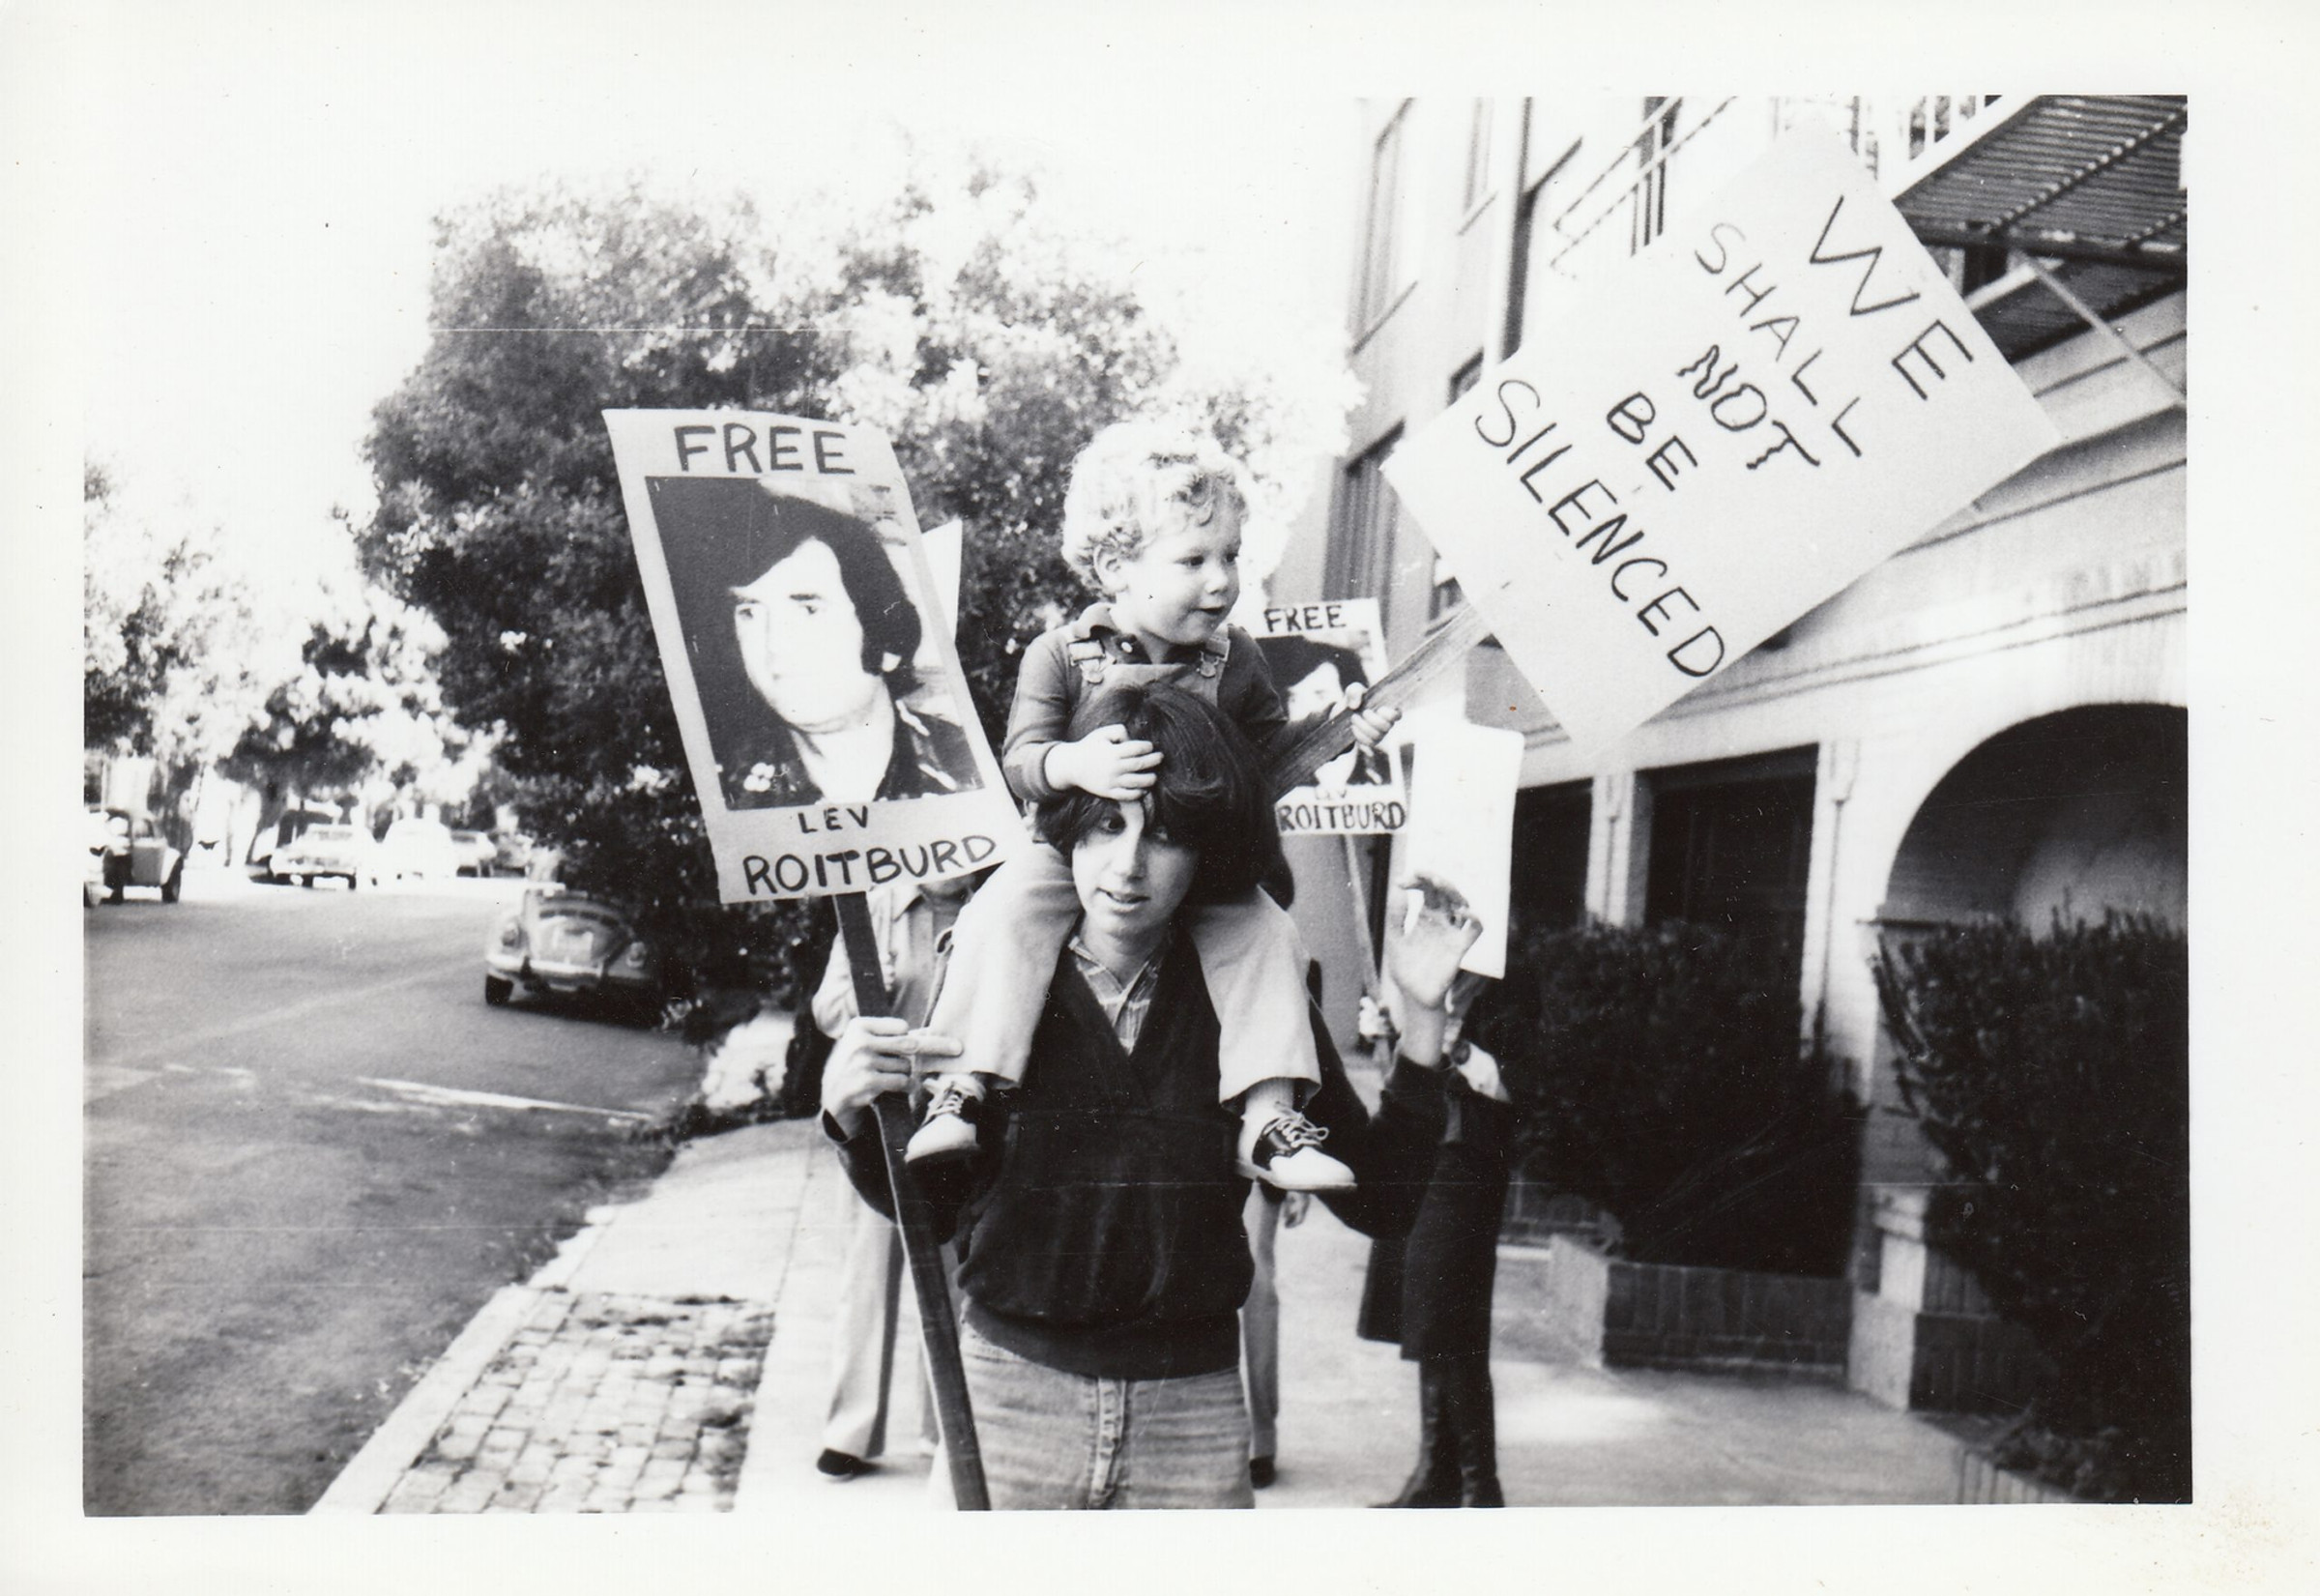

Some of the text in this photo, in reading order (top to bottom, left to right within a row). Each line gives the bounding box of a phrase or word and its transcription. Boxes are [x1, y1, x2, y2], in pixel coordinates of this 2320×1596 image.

[1808, 194, 1975, 400] WE
[1694, 222, 1862, 457] SHALL
[1605, 392, 1698, 491] BE
[1676, 343, 1820, 470] NOT
[674, 422, 856, 476] FREE
[1474, 379, 1726, 678] SILENCED
[1262, 604, 1347, 632] FREE
[798, 804, 869, 834] LEV
[1276, 801, 1406, 831] ROITBURD
[742, 835, 998, 896] ROITBURD
